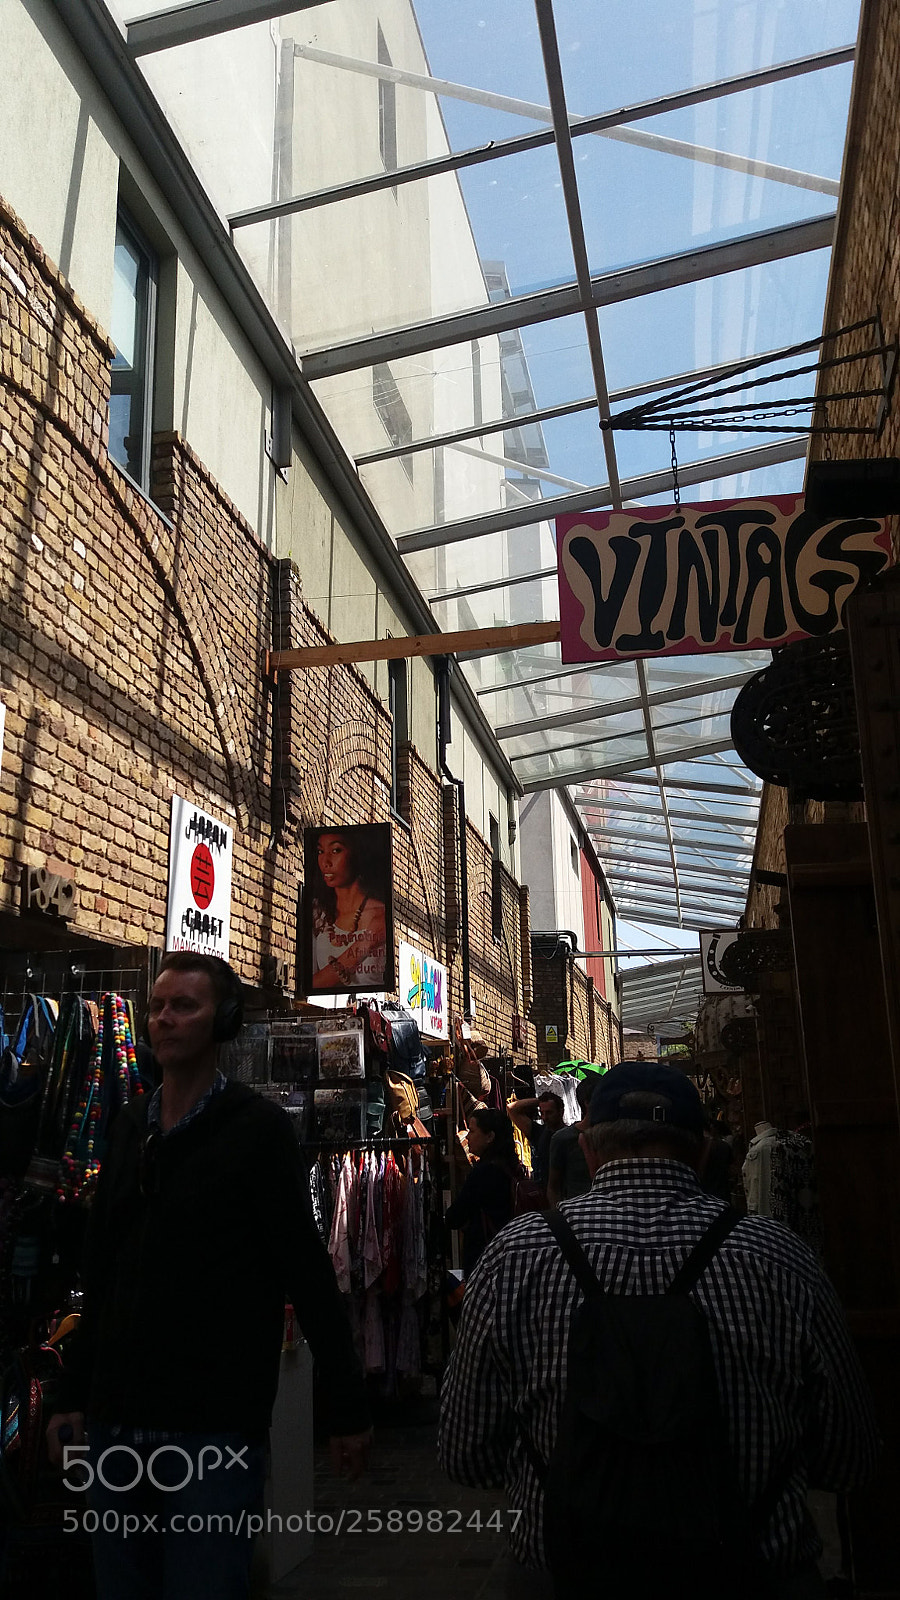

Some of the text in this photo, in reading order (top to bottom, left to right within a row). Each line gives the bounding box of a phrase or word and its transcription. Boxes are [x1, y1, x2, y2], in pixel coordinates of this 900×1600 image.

[186, 812, 228, 853] JAPAN
[182, 908, 224, 943] CRAFT
[173, 936, 200, 954] MANGA
